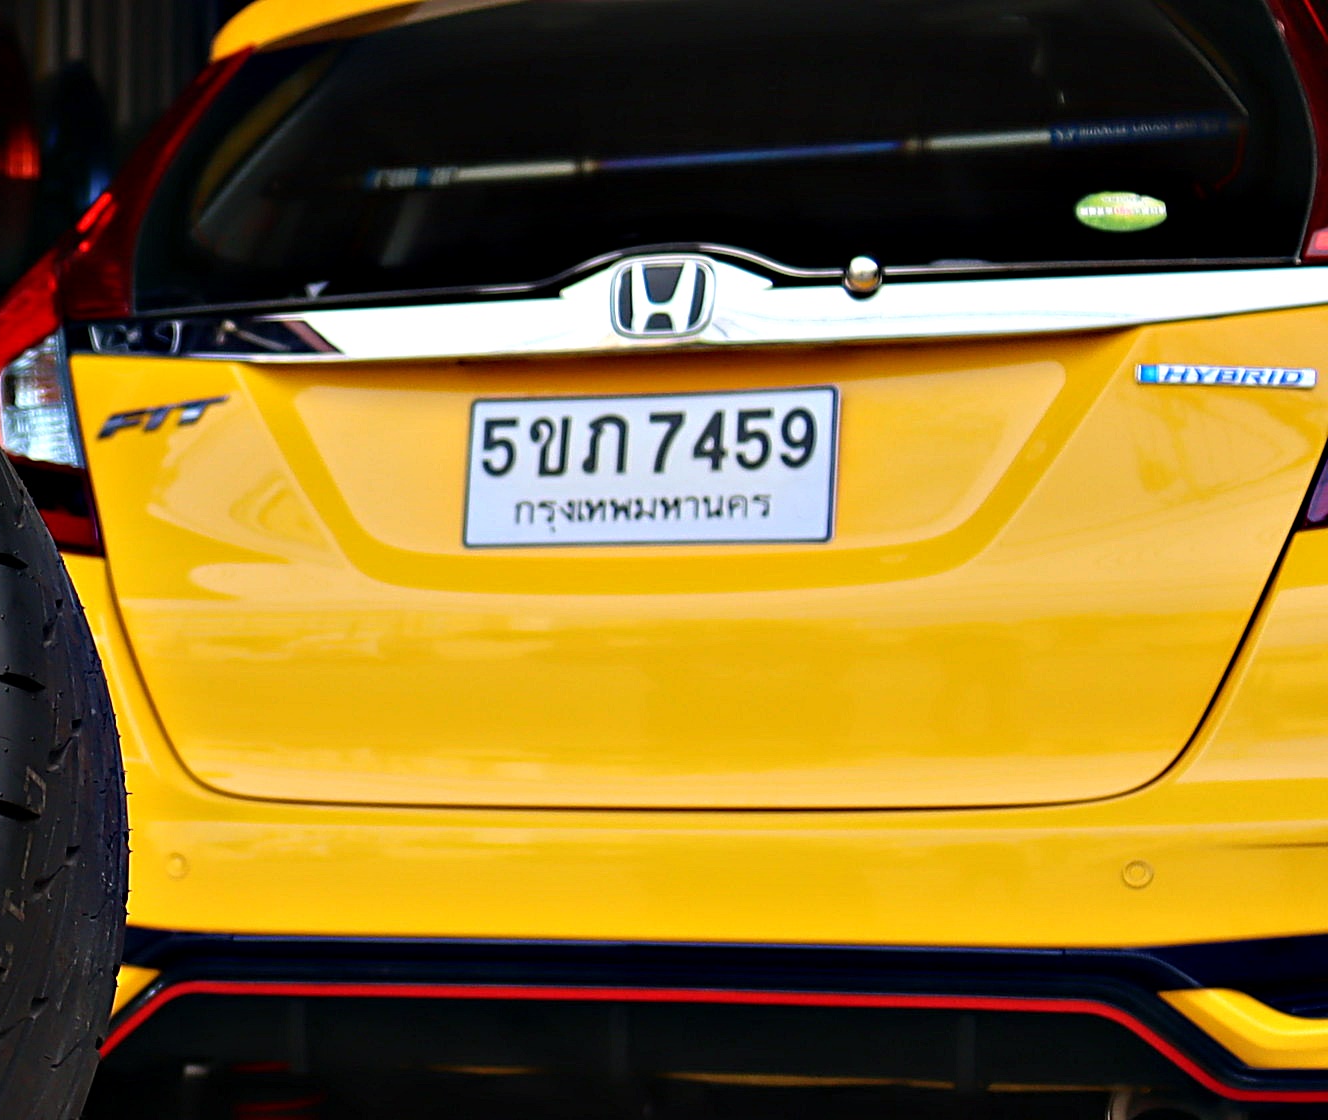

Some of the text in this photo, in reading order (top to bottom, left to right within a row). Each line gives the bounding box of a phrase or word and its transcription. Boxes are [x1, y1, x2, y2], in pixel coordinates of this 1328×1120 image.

[1162, 366, 1307, 387] HYBRID
[647, 406, 819, 475] 7459
[513, 490, 773, 533] กรุงเทพมหานคร
